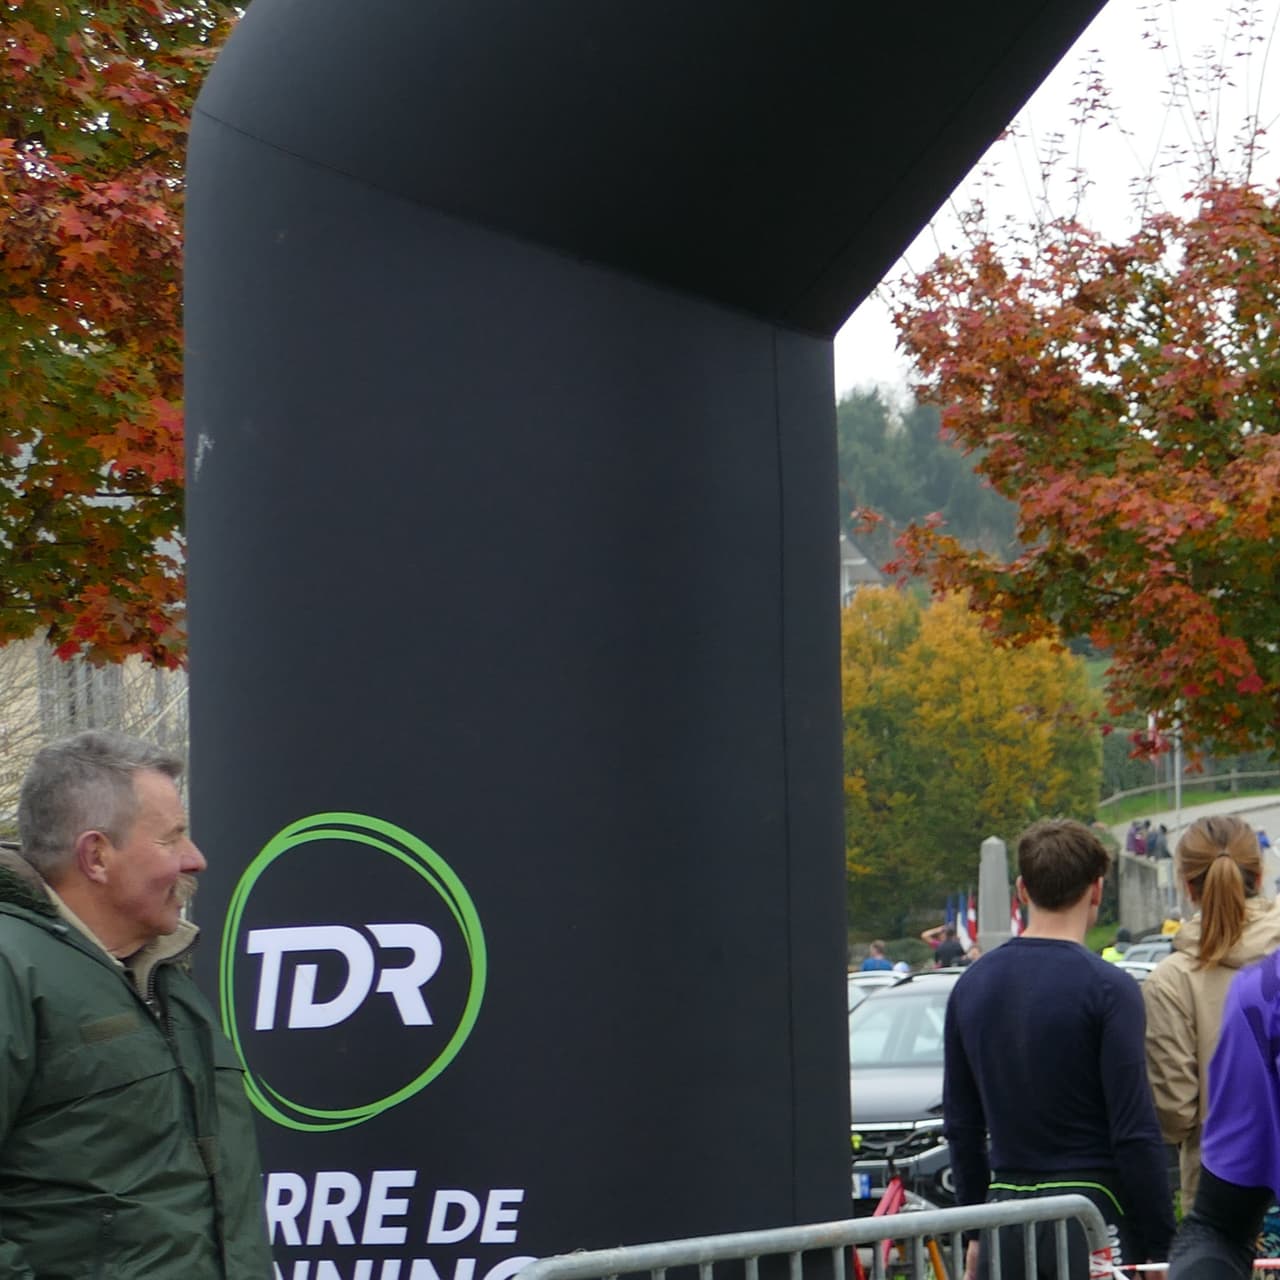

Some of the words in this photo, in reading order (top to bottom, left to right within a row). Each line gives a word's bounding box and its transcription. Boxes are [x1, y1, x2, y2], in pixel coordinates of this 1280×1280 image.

[247, 922, 442, 1031] TDR
[261, 1170, 417, 1245] RRE
[427, 1189, 524, 1243] DE
